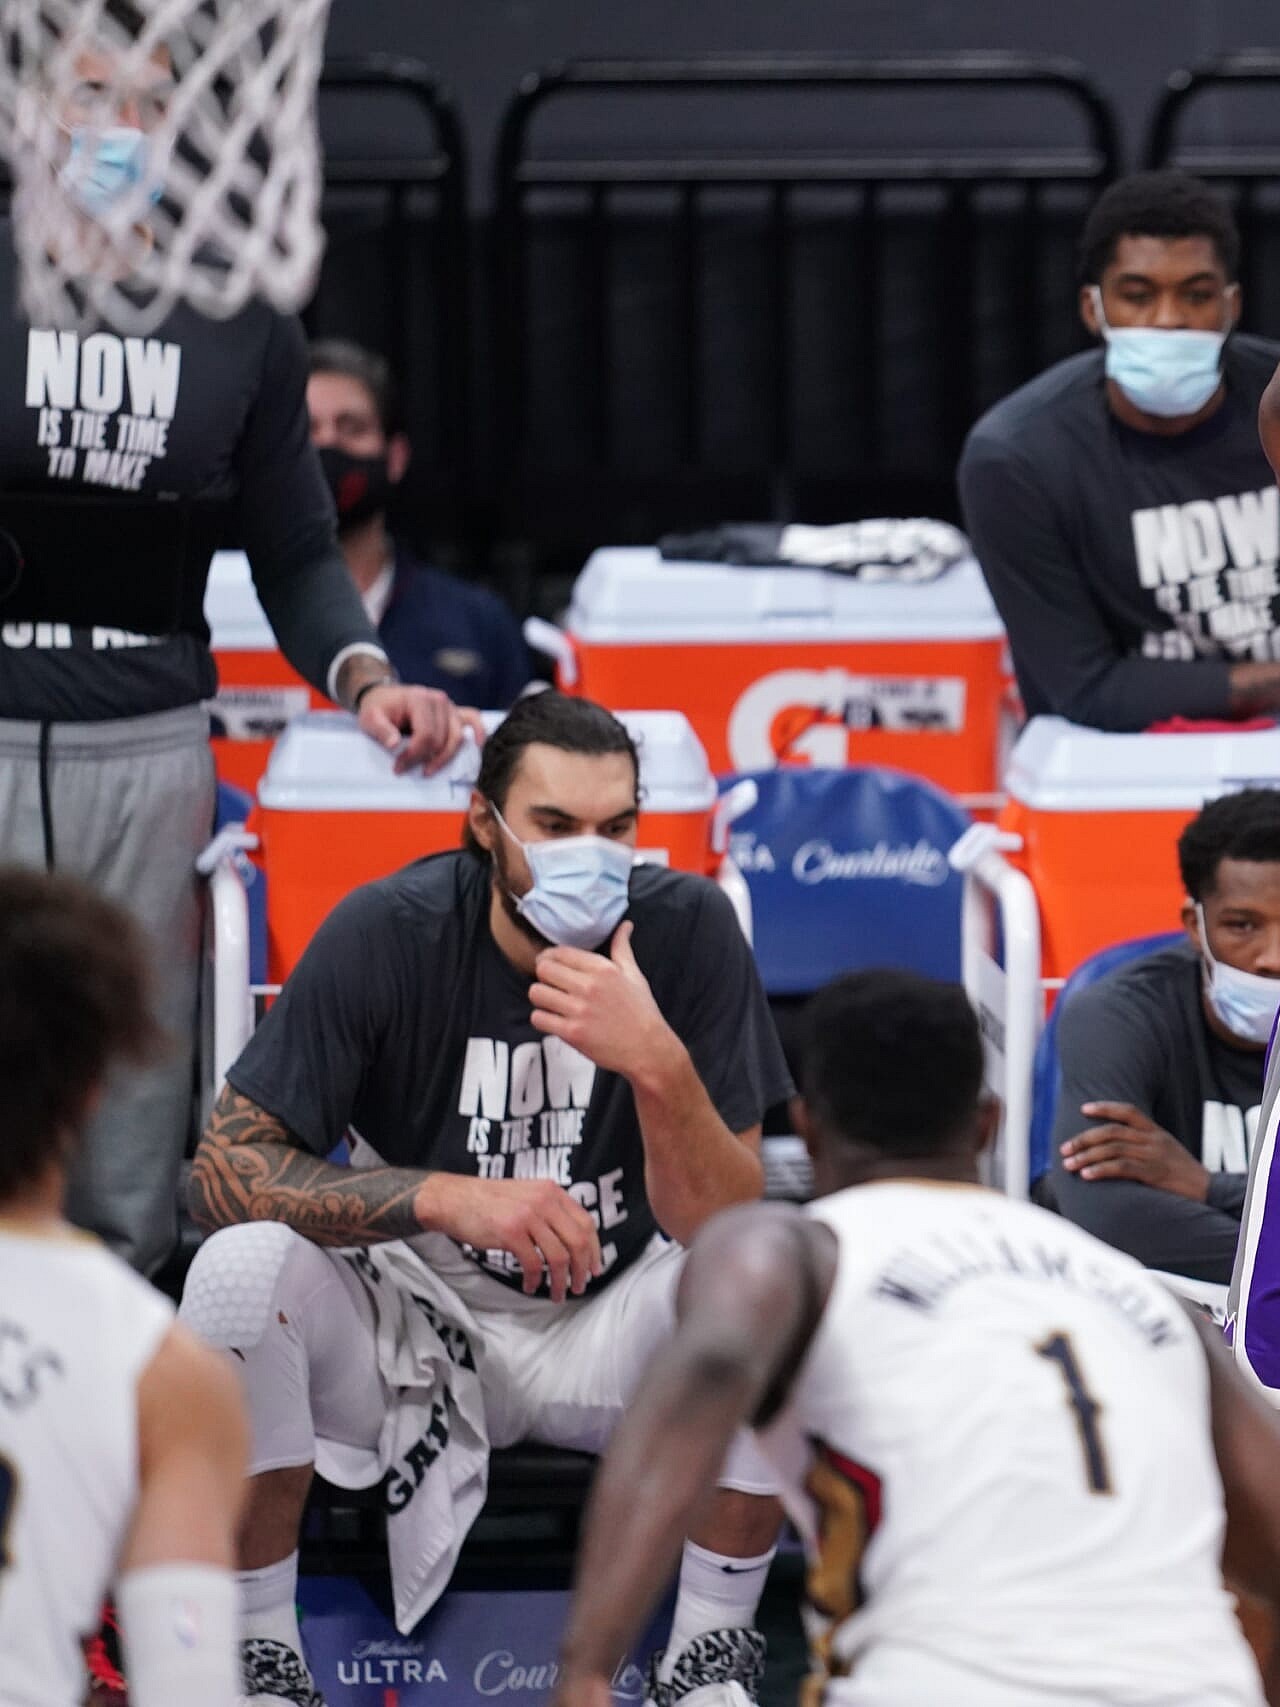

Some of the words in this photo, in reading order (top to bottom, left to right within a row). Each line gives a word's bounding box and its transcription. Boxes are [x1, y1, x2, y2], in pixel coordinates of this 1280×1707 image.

[25, 328, 181, 420] NOW
[37, 407, 62, 446] IS
[71, 410, 108, 450] THE
[117, 414, 170, 459] TIME
[48, 448, 76, 479] TO
[83, 449, 151, 491] MAKE
[1131, 485, 1280, 590] NOW
[458, 1035, 597, 1121] NOW
[467, 1117, 491, 1154] IS
[501, 1117, 533, 1154] THE
[540, 1109, 586, 1147] TIME
[477, 1153, 506, 1179] TO
[513, 1146, 573, 1187] MAKE
[1030, 1328, 1116, 1497] 1
[337, 1658, 448, 1685] ULTRA
